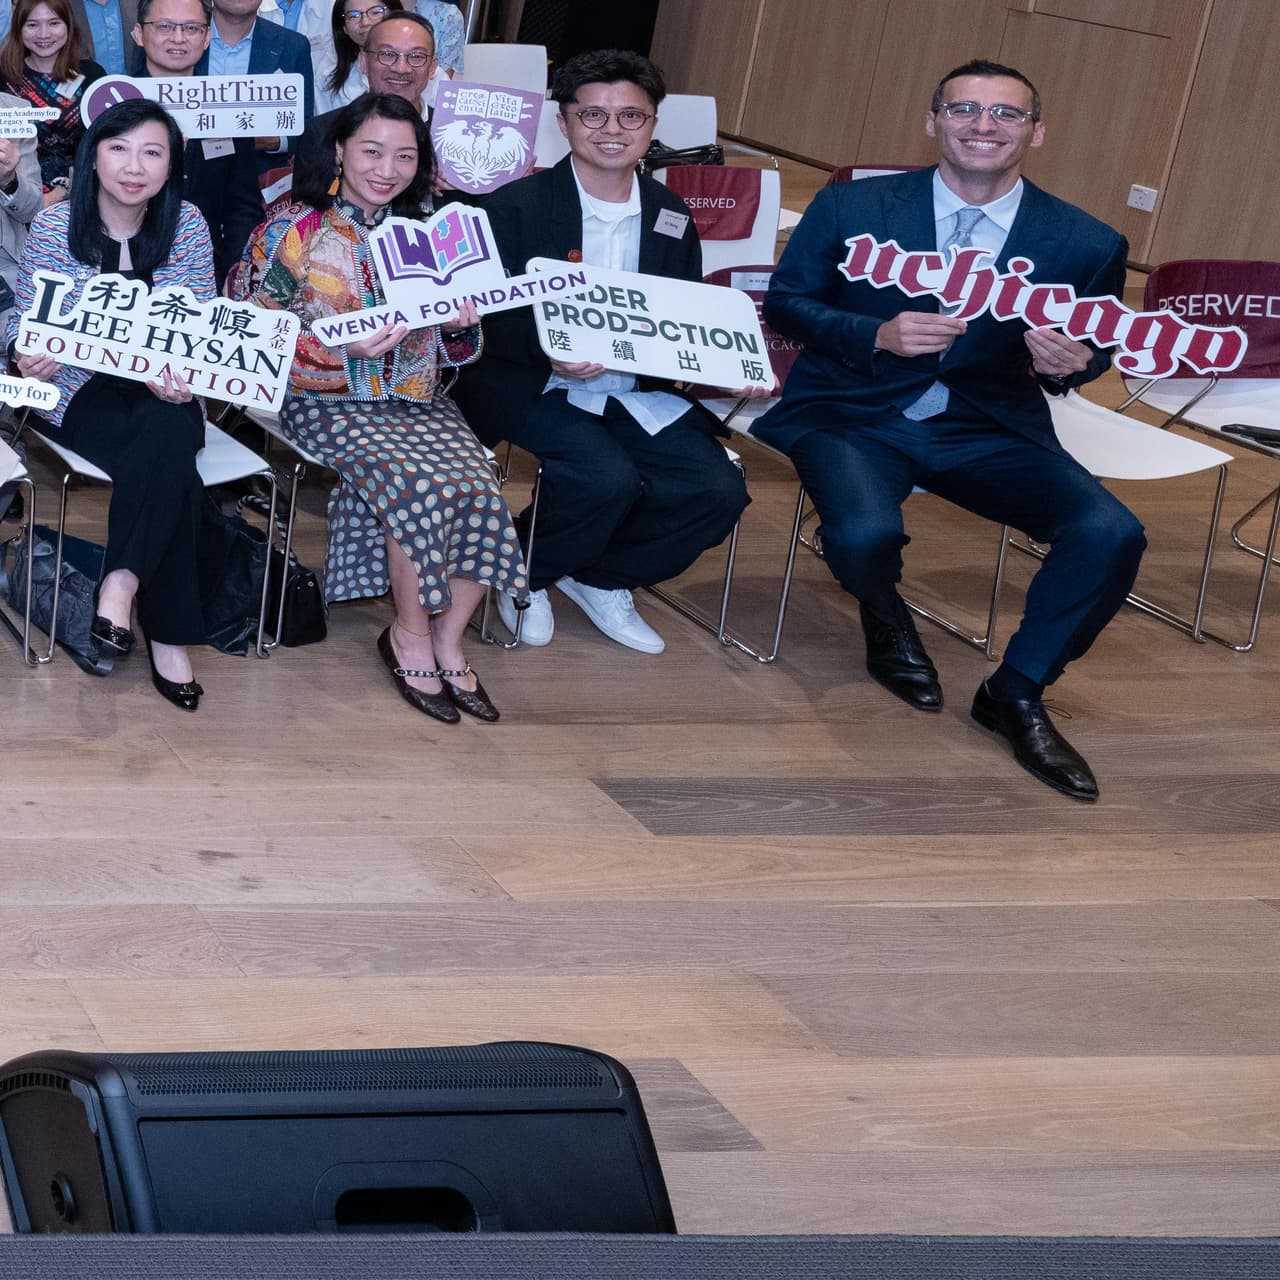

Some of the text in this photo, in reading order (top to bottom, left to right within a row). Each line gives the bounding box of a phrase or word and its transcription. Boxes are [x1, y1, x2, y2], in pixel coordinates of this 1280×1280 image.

[14, 110, 45, 118] Academy
[157, 80, 297, 109] RightTime
[27, 277, 288, 379] LEE HYSAN
[88, 280, 260, 339] 利希慎
[269, 317, 291, 351] 基金
[321, 271, 587, 340] WENYA FOUNDATION
[843, 237, 1242, 375] uchicago
[22, 330, 278, 405] FOUNDATION
[547, 328, 767, 383] 陸續出版
[27, 385, 51, 403] for
